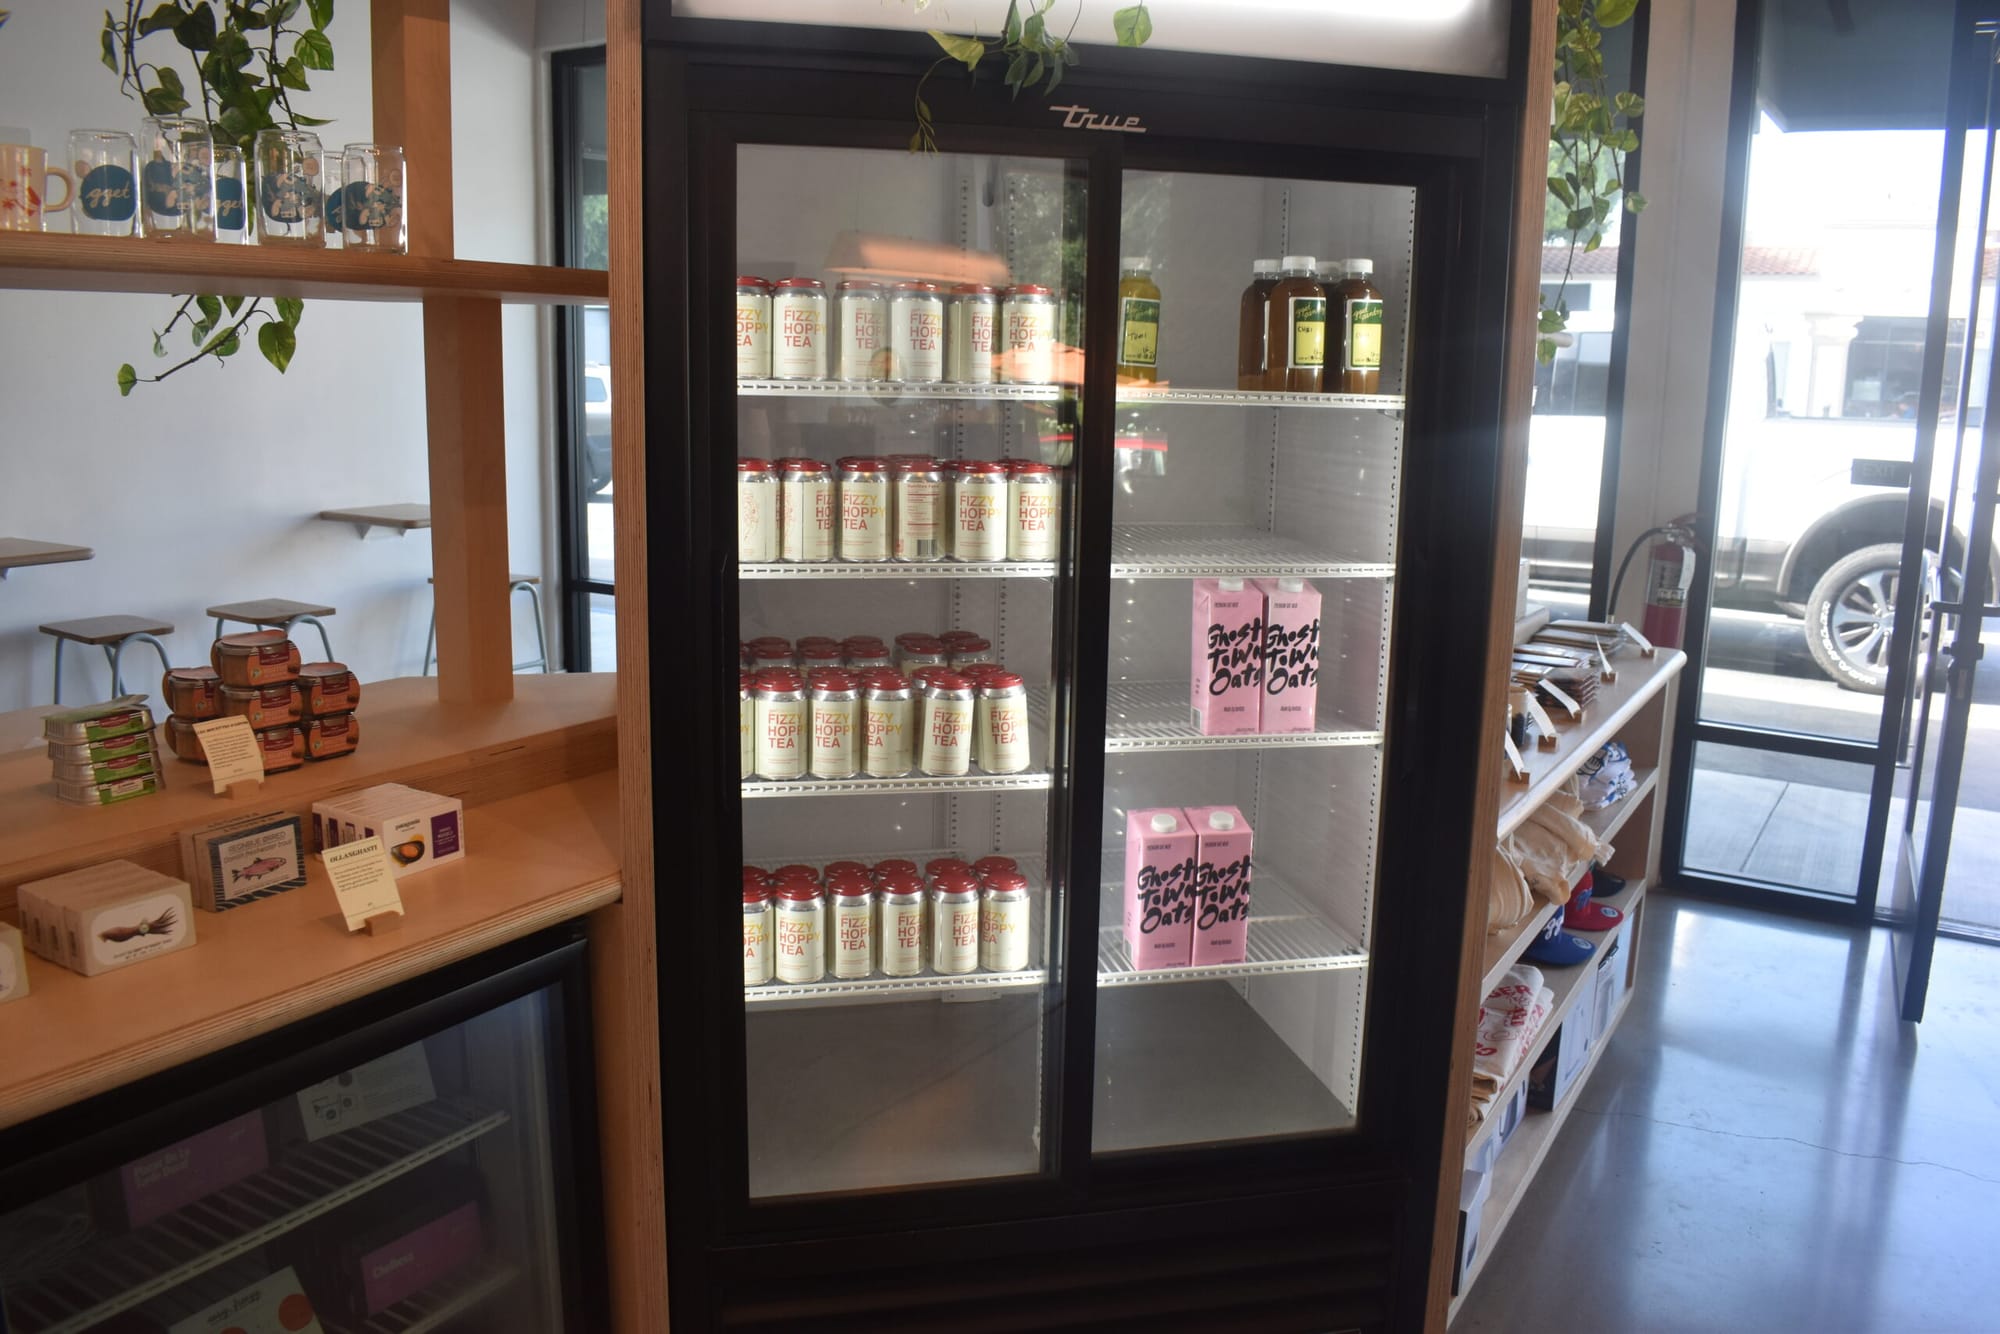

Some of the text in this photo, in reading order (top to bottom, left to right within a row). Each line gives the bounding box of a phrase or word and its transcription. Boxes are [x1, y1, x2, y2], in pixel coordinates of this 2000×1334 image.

[1049, 104, 1147, 133] true
[784, 310, 820, 321] FIZZY
[737, 321, 768, 334] OPPY
[737, 334, 753, 346] EA
[784, 335, 812, 347] TEA
[910, 339, 936, 350] TEA
[1010, 341, 1036, 352] TEA
[1863, 462, 1896, 481] EXIT
[843, 494, 877, 505] FIZZY
[960, 495, 995, 506] FIZZY
[1019, 495, 1053, 507] FIZZY
[843, 518, 868, 530] TEA
[960, 519, 985, 531] TEA
[1019, 519, 1046, 531] TEA
[1208, 617, 1263, 649] Ghost
[1267, 618, 1320, 649] Ghost
[768, 713, 803, 725] FIZZY
[815, 712, 849, 724] FIZZY
[865, 723, 903, 736] OPPY
[768, 737, 795, 749] TEA
[815, 736, 841, 748] TEA
[933, 735, 958, 747] TEA
[992, 733, 1018, 745] TEA
[1138, 857, 1196, 890] Ghost
[1197, 855, 1252, 886] Ghost
[779, 920, 813, 933] FIZZY
[983, 921, 1015, 934] OPPY
[841, 939, 867, 951] TEA
[898, 937, 922, 949] TEA
[953, 936, 976, 948] TEA
[779, 943, 804, 956] TEA
